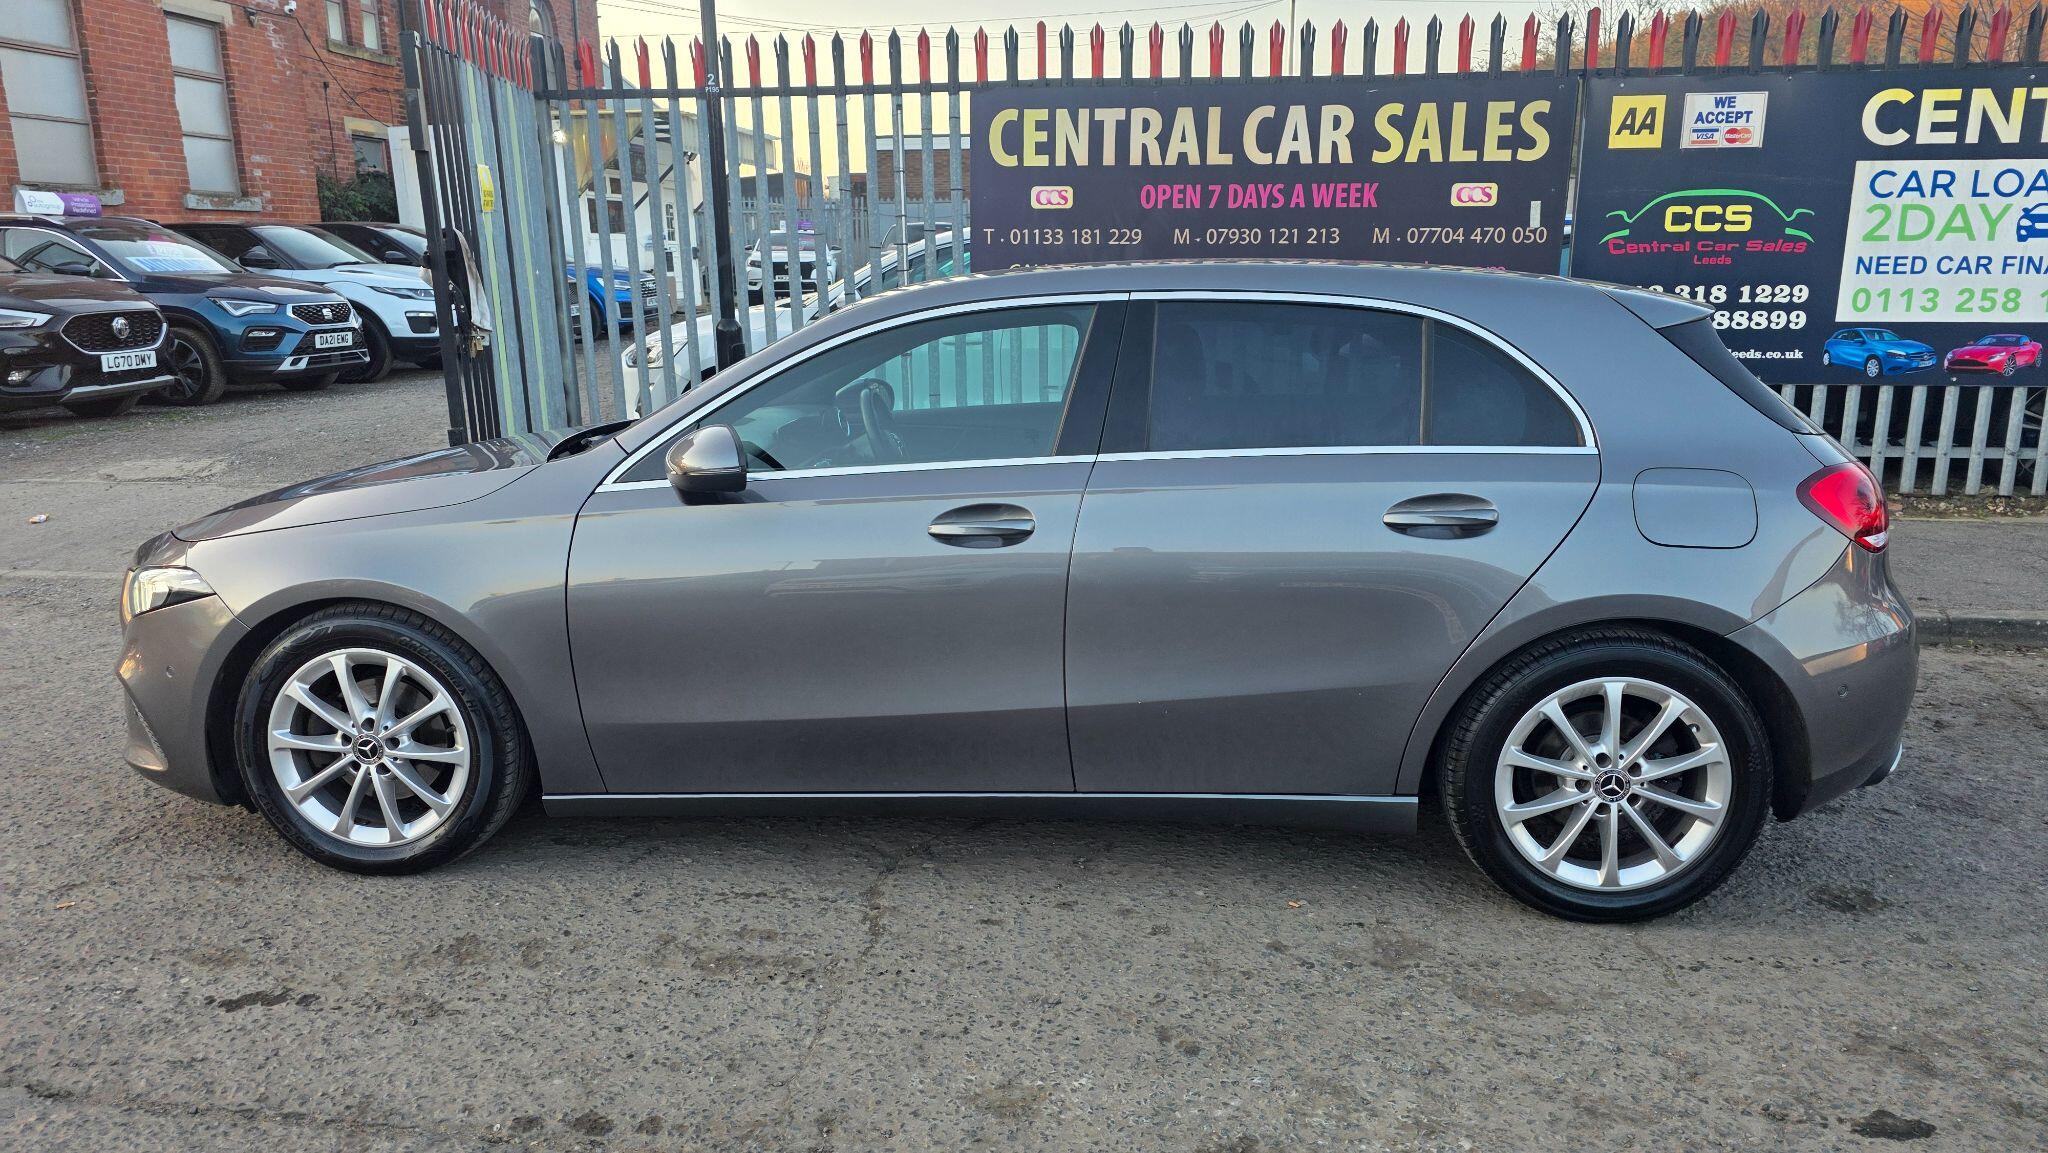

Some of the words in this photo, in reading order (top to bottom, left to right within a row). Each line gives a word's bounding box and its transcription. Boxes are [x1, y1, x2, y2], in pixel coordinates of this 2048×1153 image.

[707, 73, 715, 85] 2
[1714, 96, 1737, 109] WE
[1615, 107, 1657, 136] AA
[1693, 111, 1754, 125] ACCEPT
[988, 107, 1233, 167] CENTRAL
[1243, 104, 1354, 165] CAR
[1371, 100, 1551, 164] SALES
[1869, 169, 1956, 198] CAR
[1140, 184, 1201, 209] OPEN
[1209, 185, 1222, 208] 7
[1228, 183, 1285, 208] DAYS
[1289, 183, 1306, 208] A
[1311, 183, 1380, 208] WEEK
[1664, 205, 1752, 232] CCS
[1862, 203, 2013, 242] 2DAY
[1010, 229, 1064, 245] 01133
[1071, 229, 1100, 244] 181
[1108, 229, 1142, 245] 229
[1206, 228, 1261, 244] 07930
[1269, 228, 1298, 244] 121
[1306, 228, 1340, 244] 213
[1407, 227, 1464, 243] 07704
[1470, 227, 1506, 243] 470
[1511, 226, 1547, 243] 050
[1608, 239, 1690, 255] Central
[1697, 240, 1739, 252] Car
[1746, 239, 1807, 253] Sales
[1694, 255, 1732, 265] Leeds
[1855, 256, 1928, 275] NEED
[1936, 256, 1993, 275] CAR
[1738, 284, 1810, 303] 1229
[1851, 287, 1940, 313] 0113
[1954, 287, 2022, 313] 258
[319, 335, 336, 346] DA21
[106, 355, 133, 369] LG70
